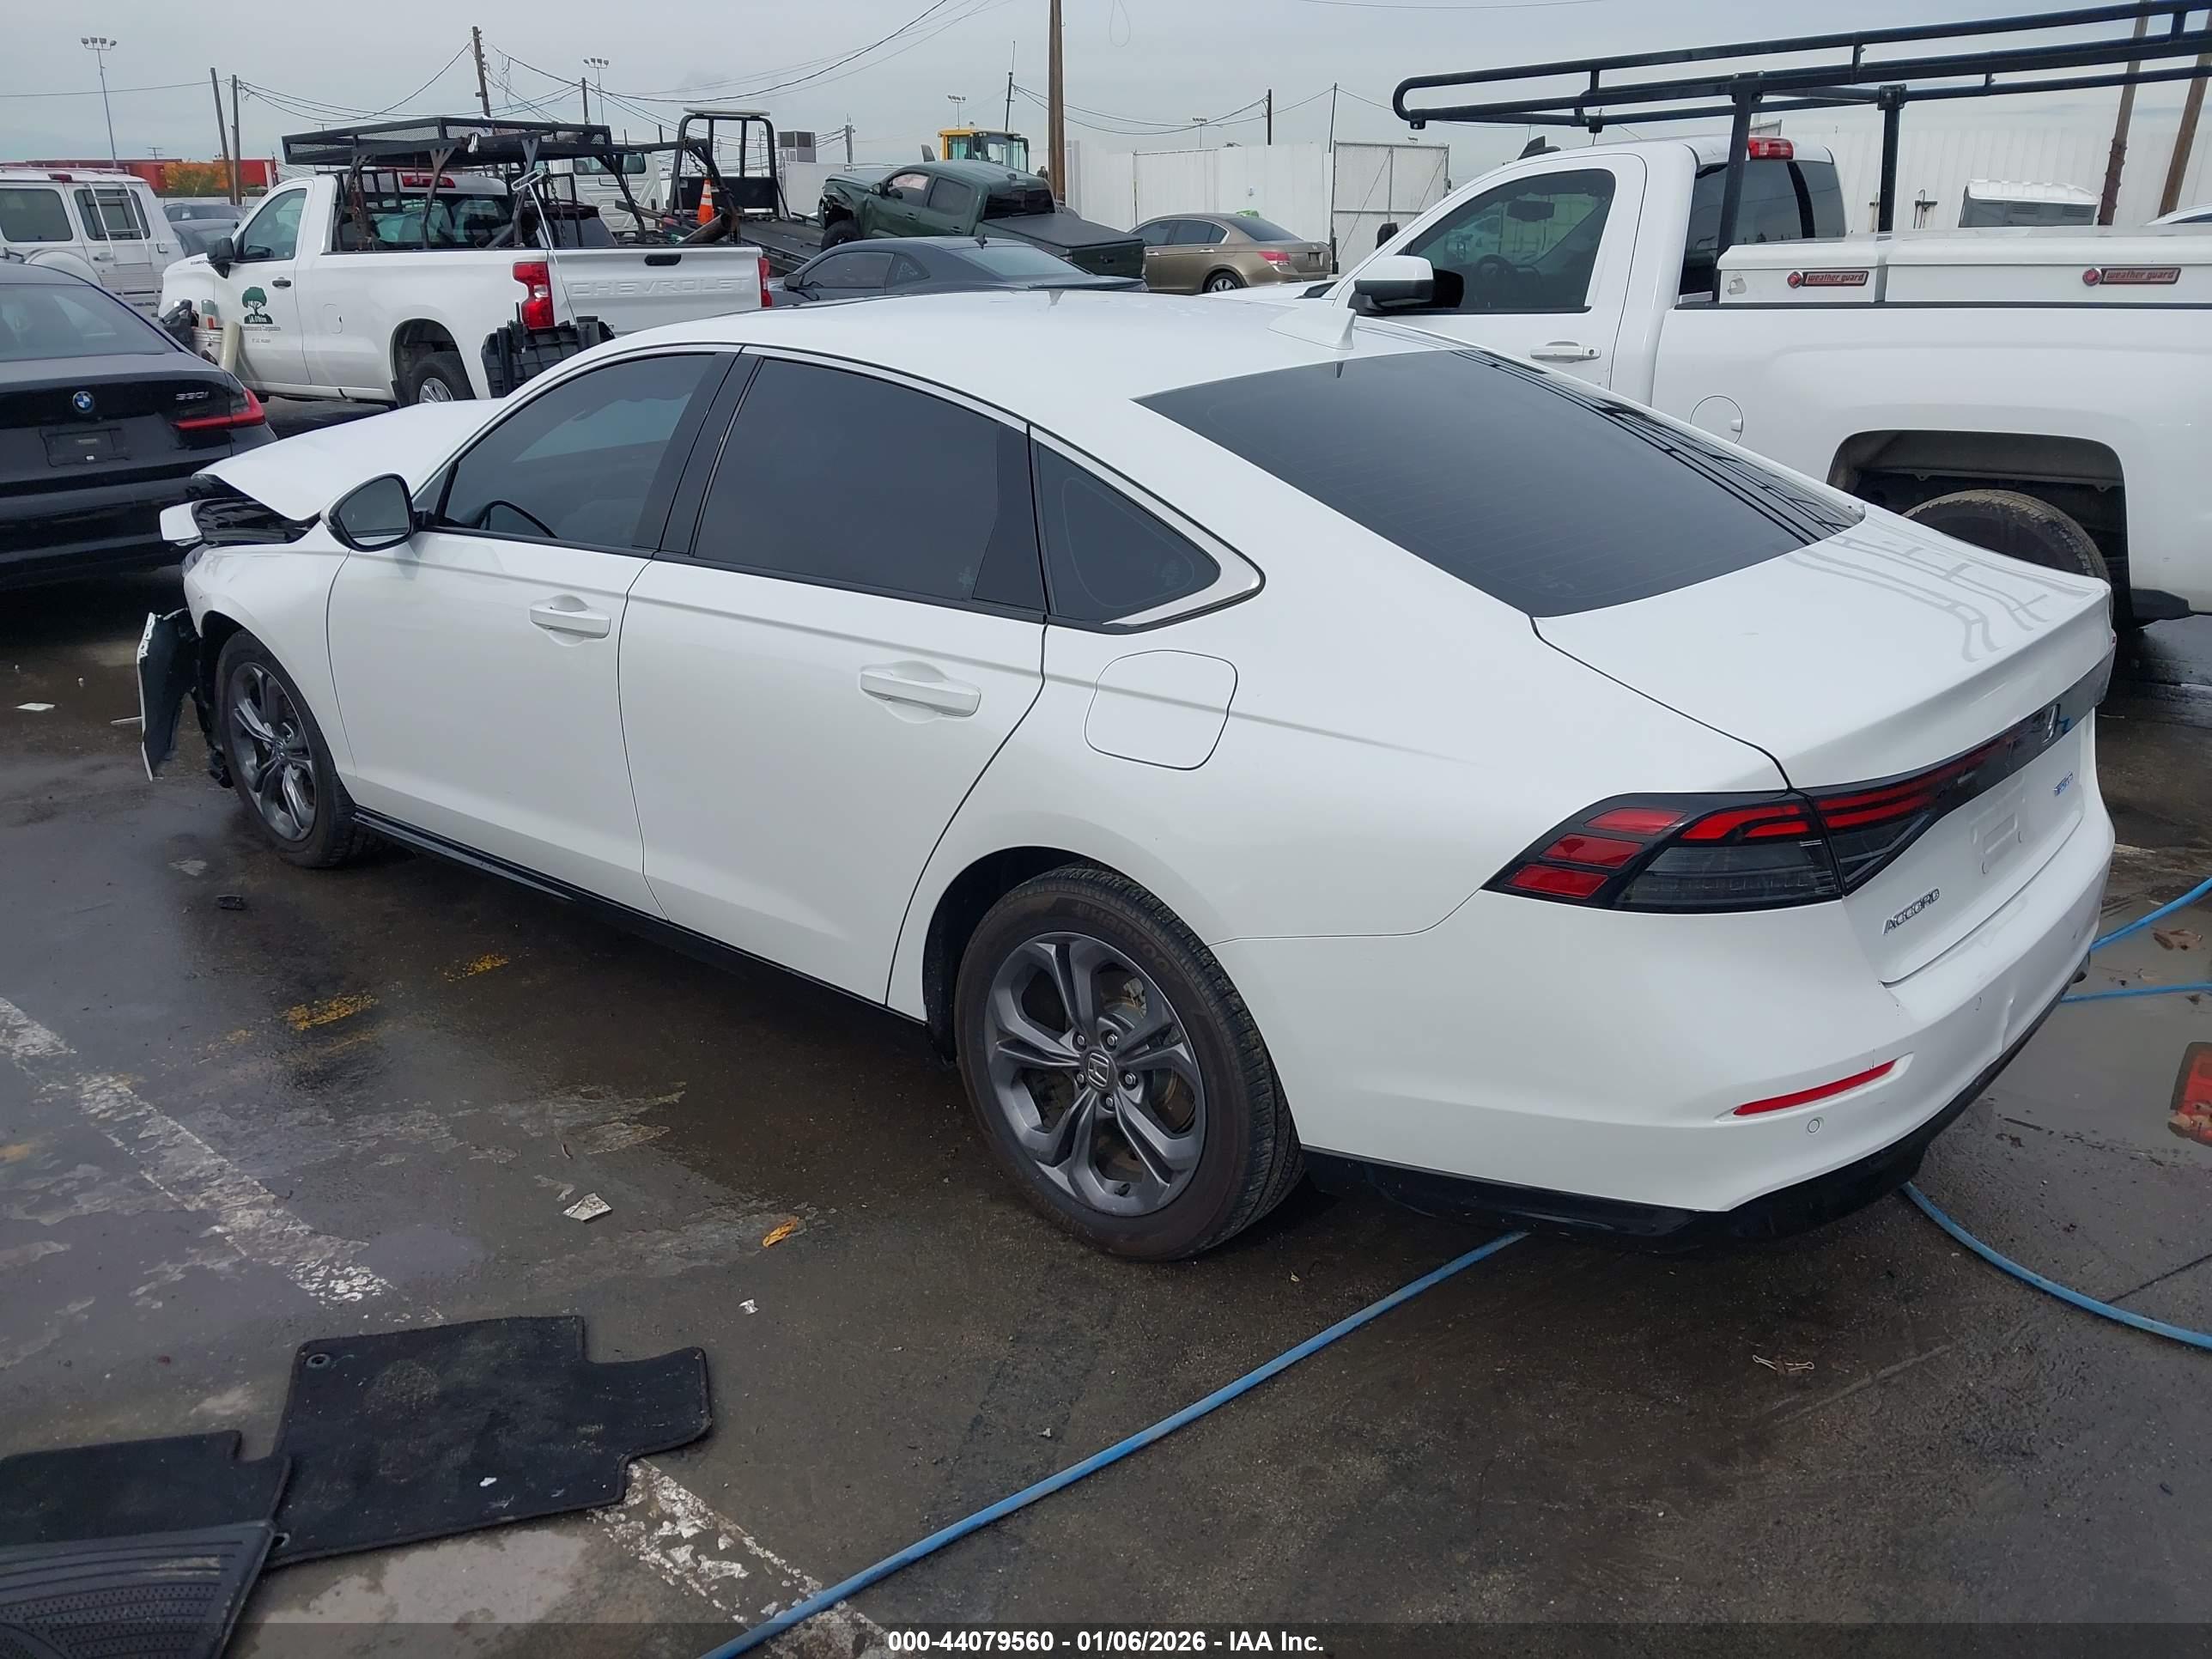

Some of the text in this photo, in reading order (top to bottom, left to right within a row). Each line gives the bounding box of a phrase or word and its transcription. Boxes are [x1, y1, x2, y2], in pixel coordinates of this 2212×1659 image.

[1808, 273, 1865, 283] weather guard
[2107, 270, 2175, 280] weather guard
[569, 276, 750, 297] CHEVROLET
[1882, 888, 1940, 935] ACCORD
